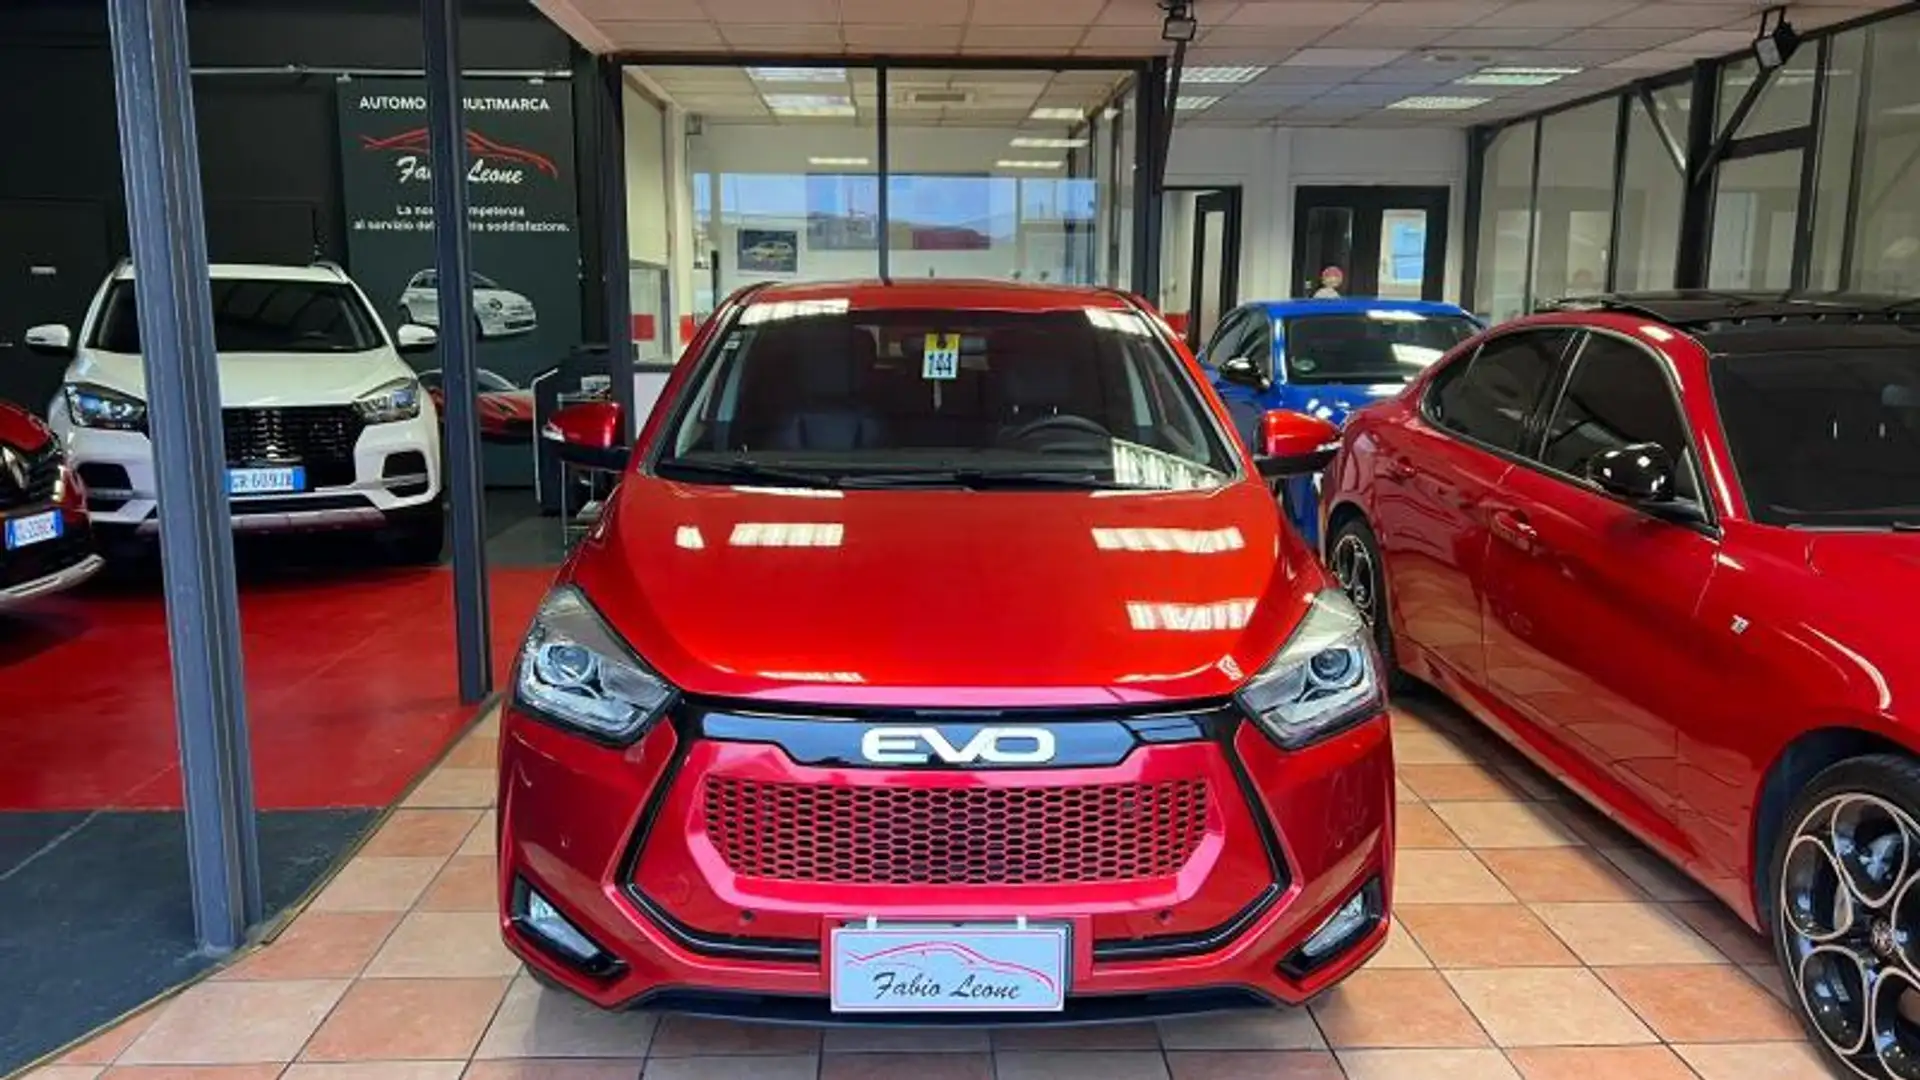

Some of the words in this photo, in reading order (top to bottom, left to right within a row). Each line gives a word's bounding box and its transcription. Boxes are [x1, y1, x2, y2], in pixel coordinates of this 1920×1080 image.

[359, 97, 427, 110] AUTOMO
[467, 158, 524, 184] Leone
[862, 727, 1055, 763] EVO
[873, 971, 942, 1000] Fabio
[950, 973, 1022, 1000] Leone
